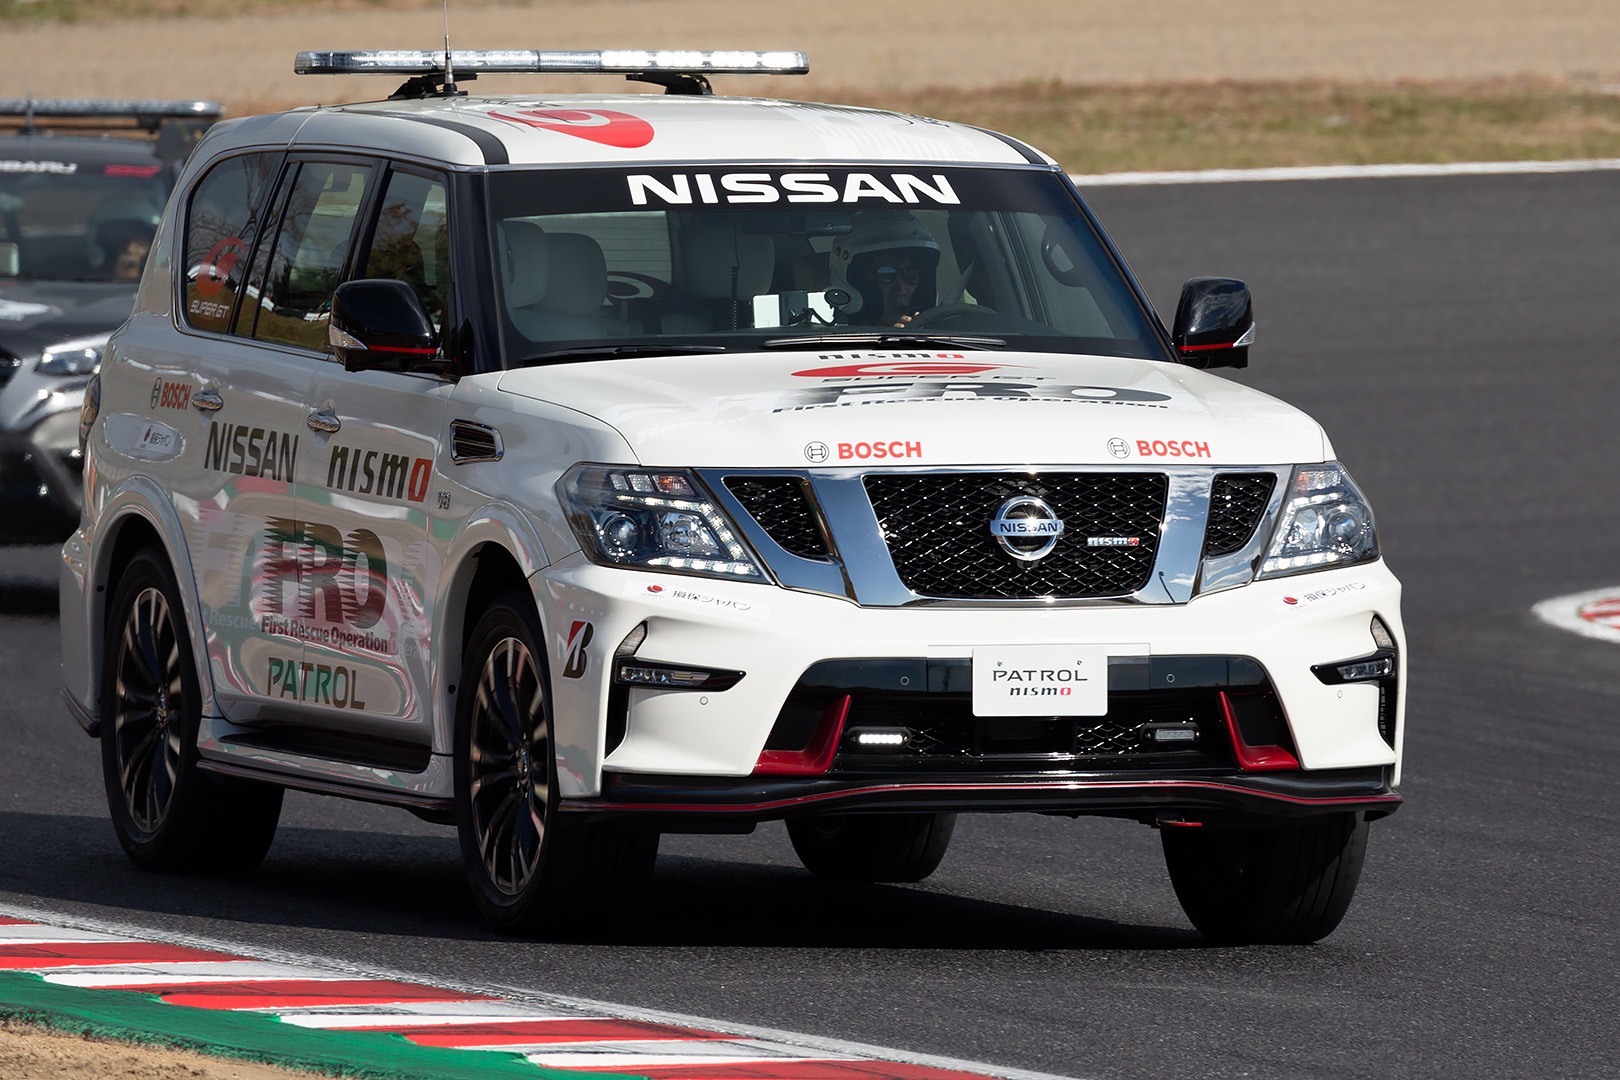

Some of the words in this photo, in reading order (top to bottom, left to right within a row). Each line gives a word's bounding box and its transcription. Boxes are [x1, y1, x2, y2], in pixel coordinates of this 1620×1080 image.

[626, 173, 961, 205] NISSAN
[190, 299, 217, 316] SUPER
[160, 381, 192, 411] BOSCH
[204, 421, 299, 483] NISSAN
[837, 441, 922, 460] BOSCH
[1136, 439, 1211, 458] BOSCH
[999, 522, 1058, 532] NISSAN
[262, 514, 388, 630] FRO
[261, 615, 289, 637] First
[290, 620, 330, 643] Rescue
[331, 626, 389, 653] Operation
[267, 657, 366, 710] PATROL
[993, 669, 1088, 682] PATROL
